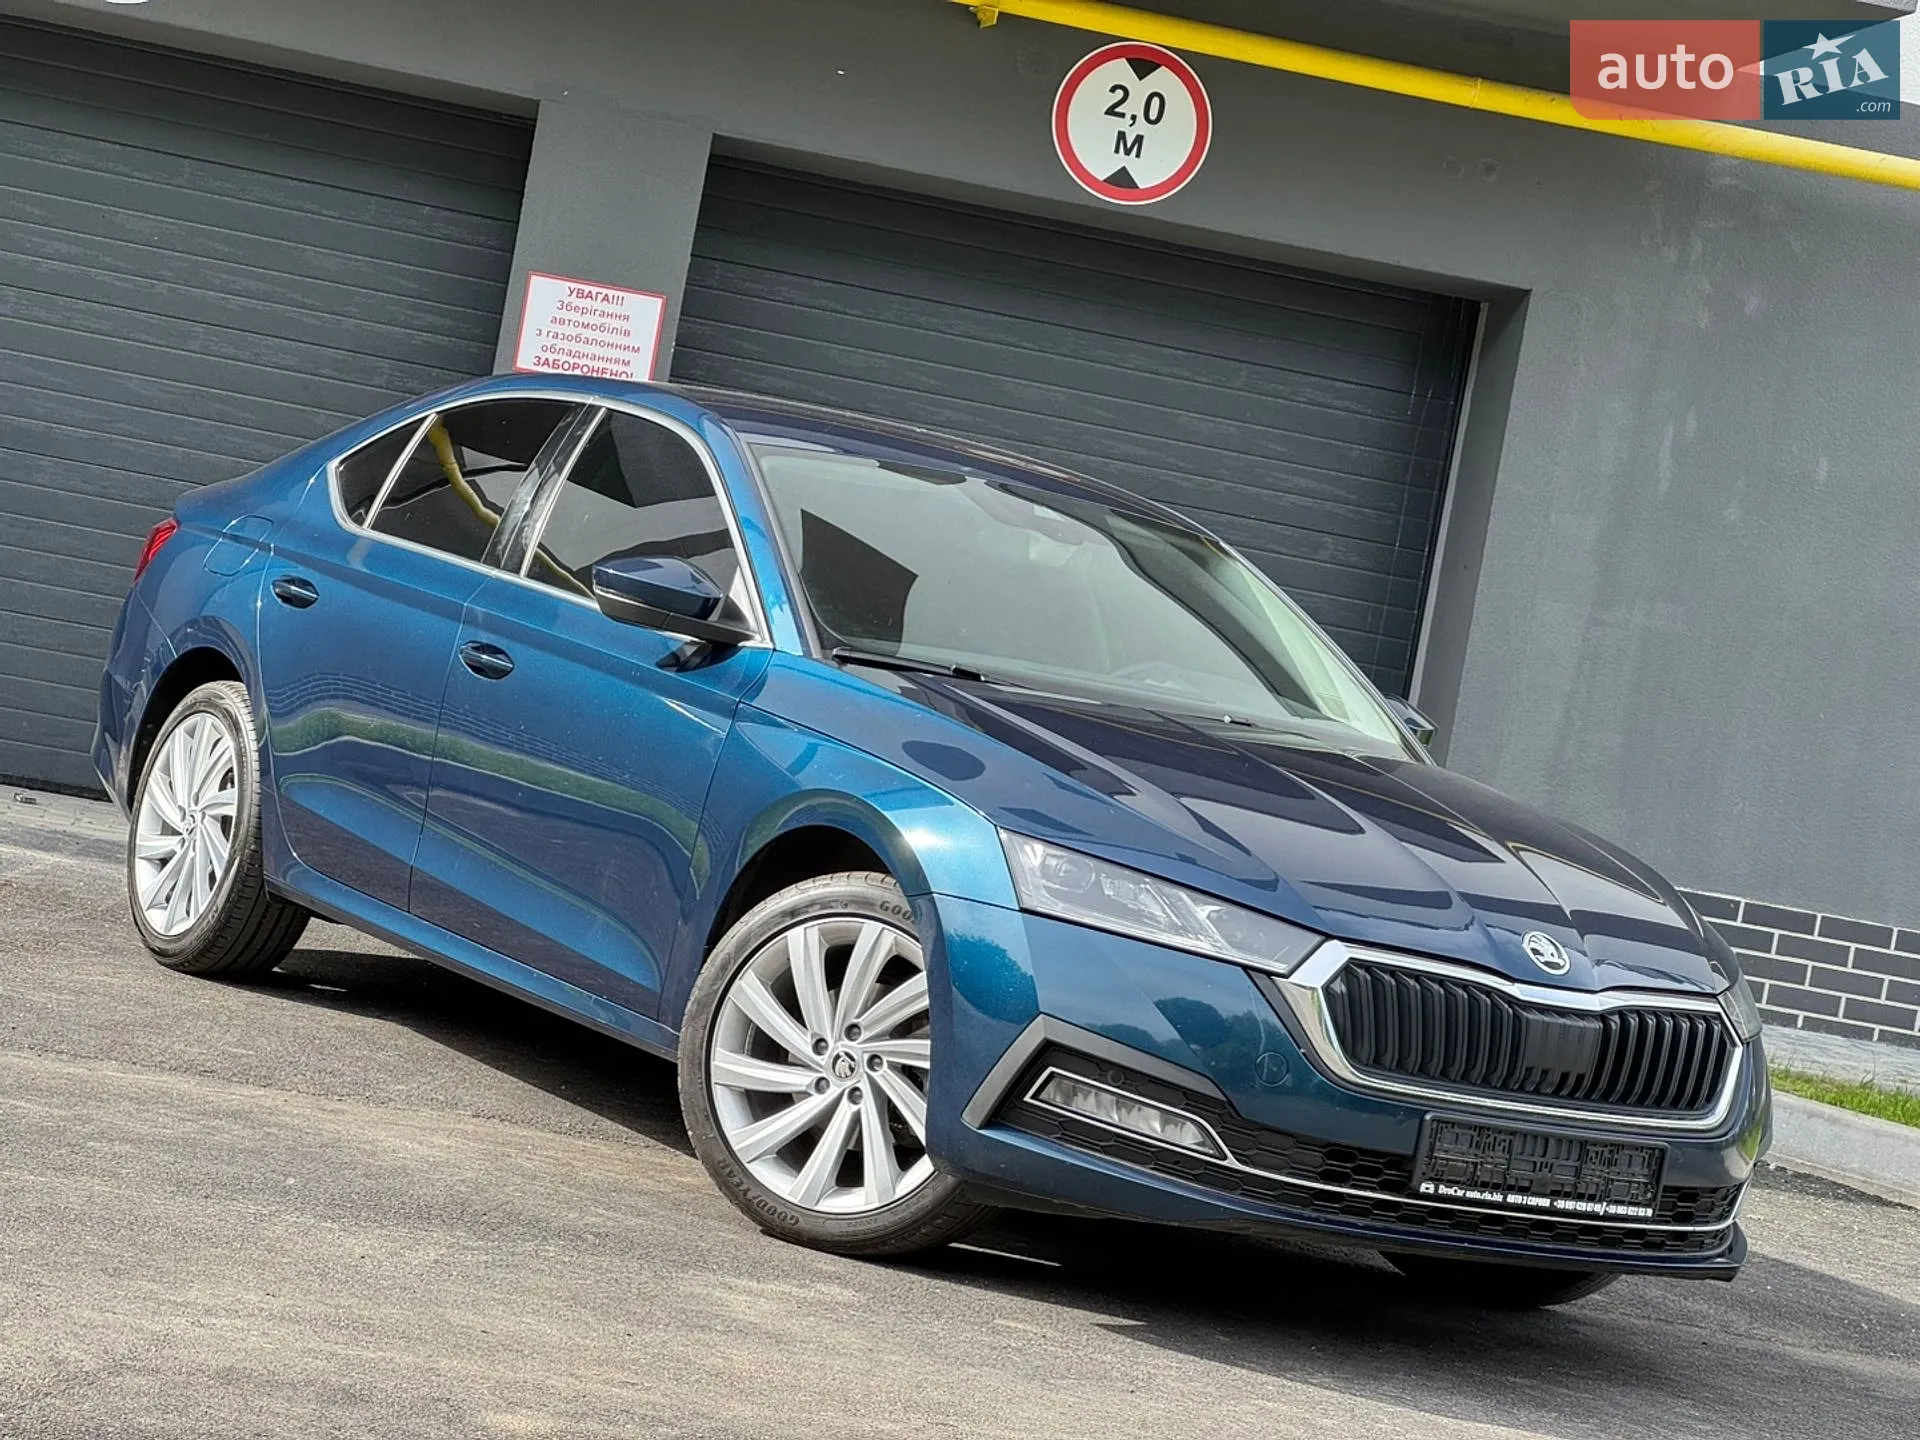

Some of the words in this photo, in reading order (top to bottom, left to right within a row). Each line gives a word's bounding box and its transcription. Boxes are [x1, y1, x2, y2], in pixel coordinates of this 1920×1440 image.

[1104, 84, 1167, 128] 2,0
[567, 286, 625, 307] УВАГА!!!
[556, 300, 631, 323] Зберігання
[550, 315, 632, 338] автомобілів
[536, 328, 543, 337] з
[546, 331, 641, 354] газобалонним
[541, 343, 631, 367] обладнанням
